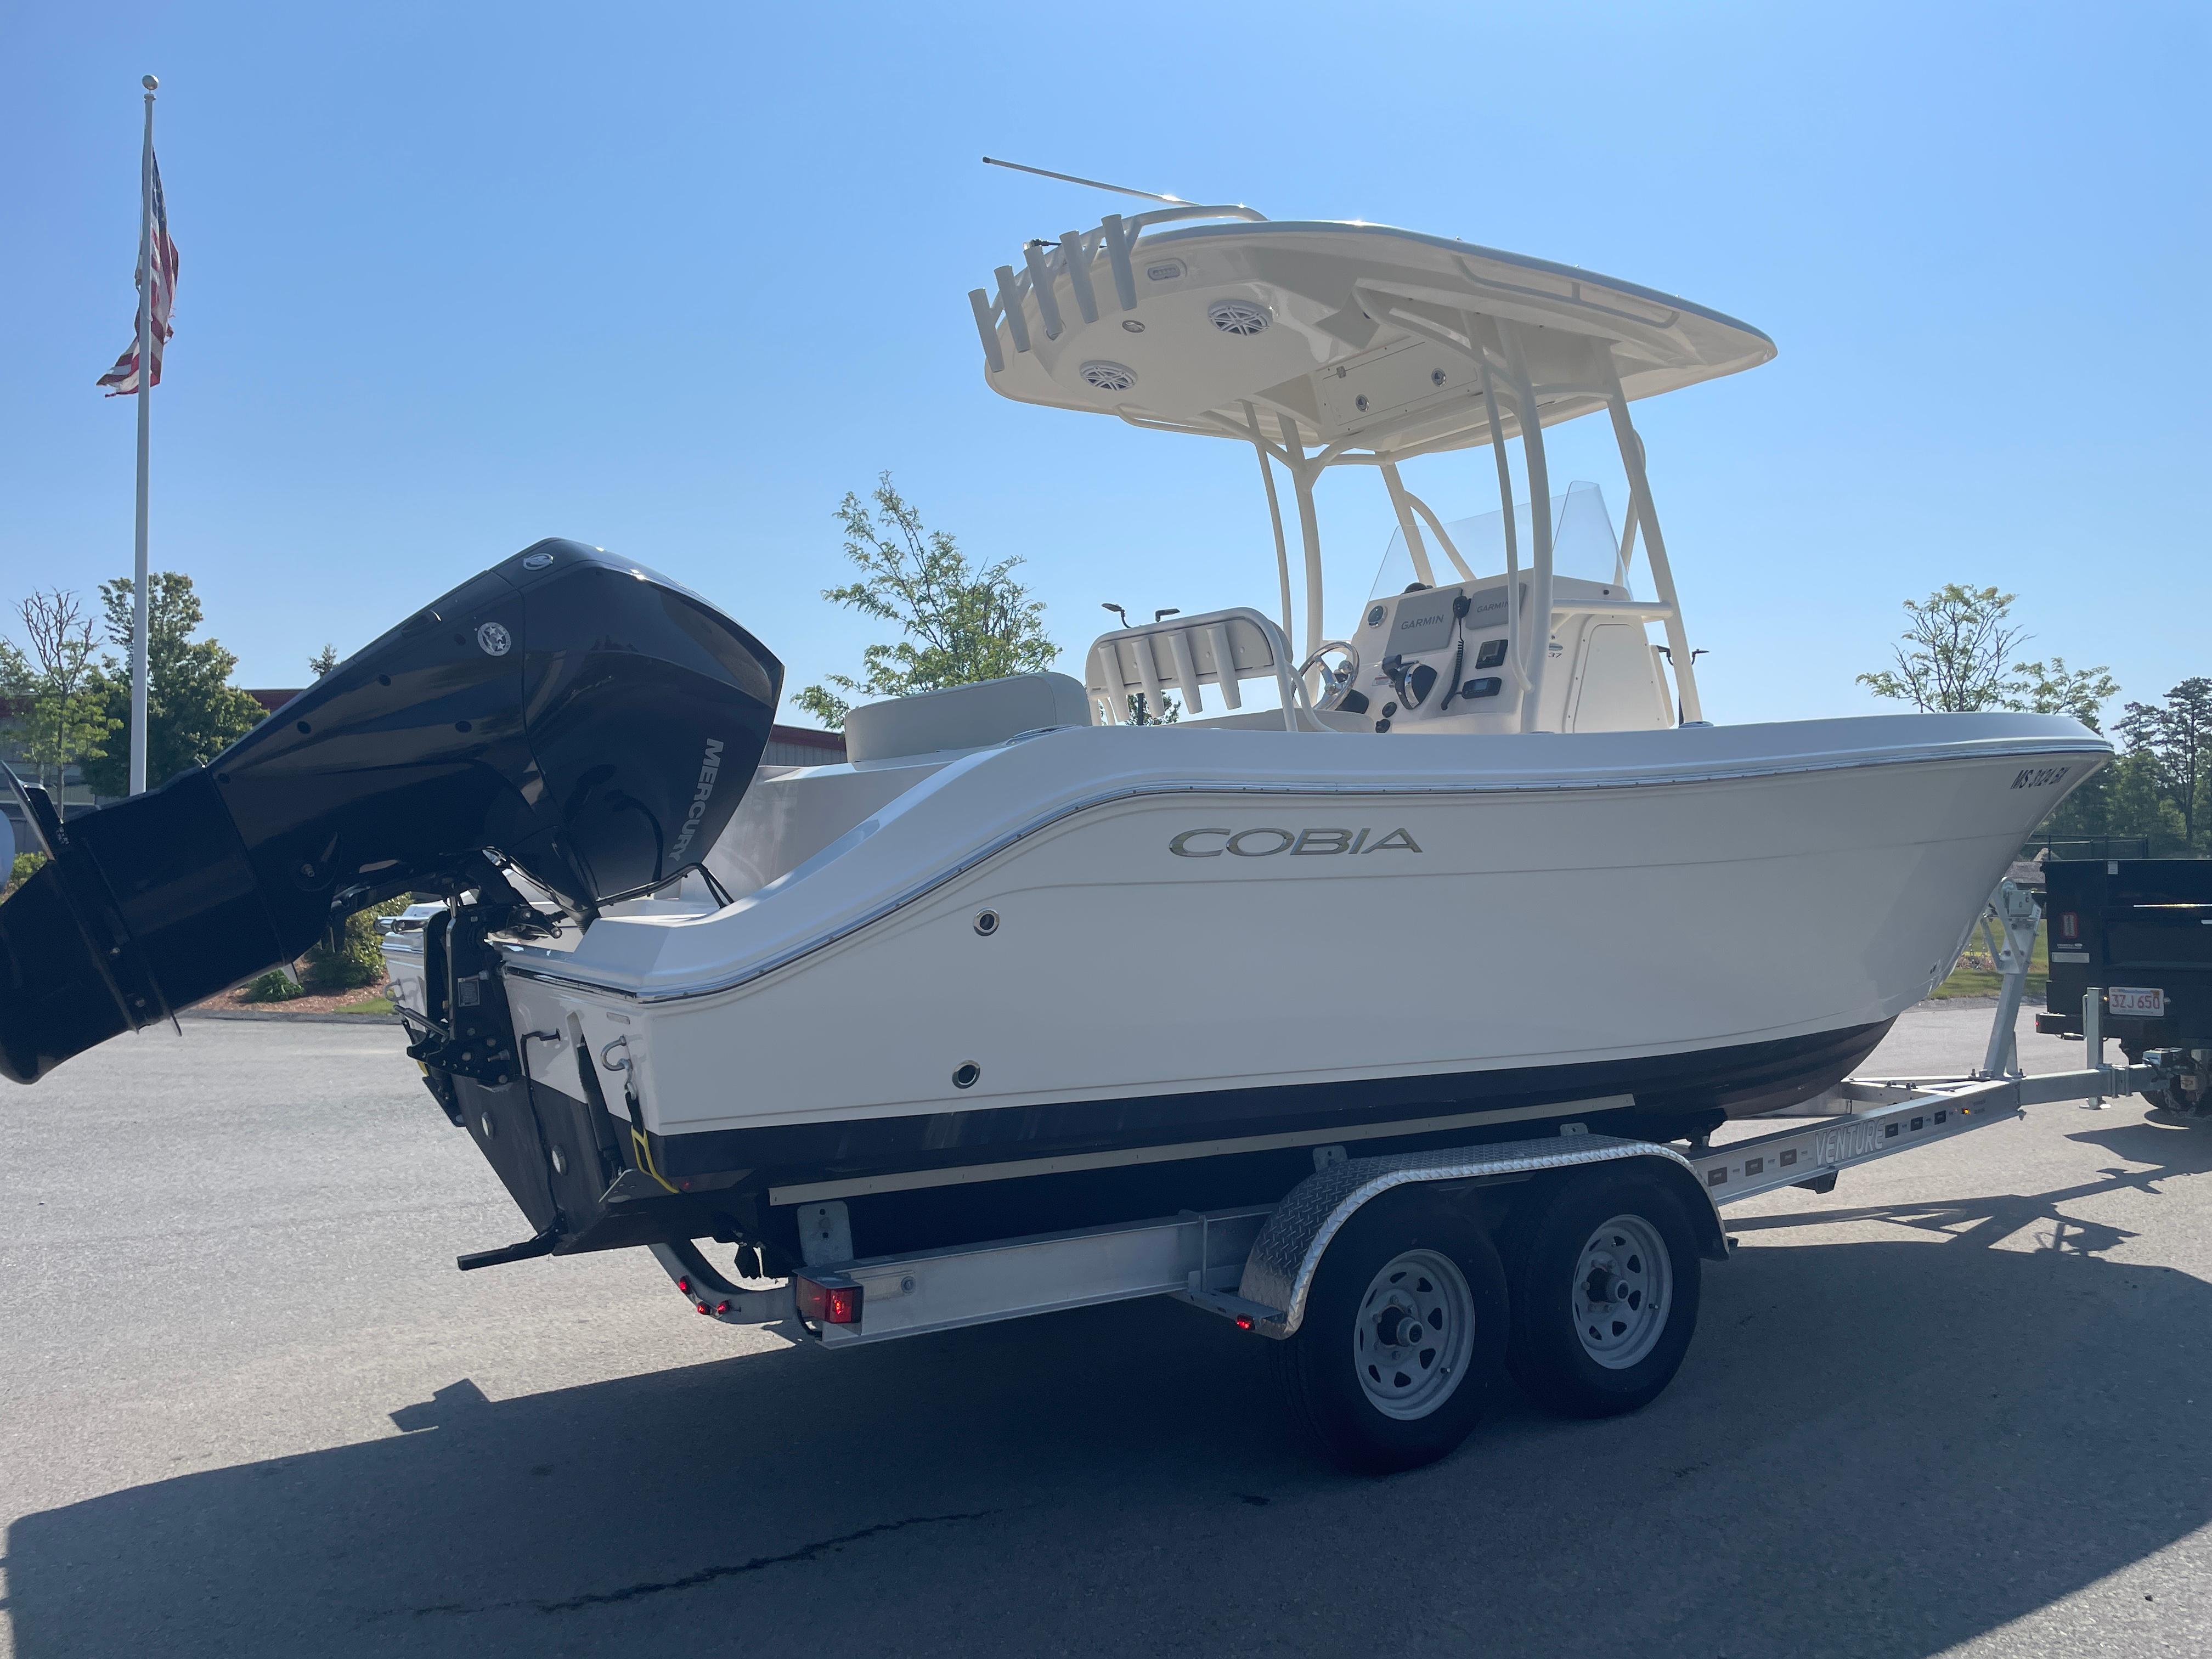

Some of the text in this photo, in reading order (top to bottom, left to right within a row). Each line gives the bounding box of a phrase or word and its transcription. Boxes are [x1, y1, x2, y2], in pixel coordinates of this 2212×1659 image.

[1401, 614, 1444, 630] GARMIN
[668, 738, 724, 861] MERCURY
[1169, 827, 1424, 857] COBIA
[1815, 1115, 1887, 1166] VENTURE
